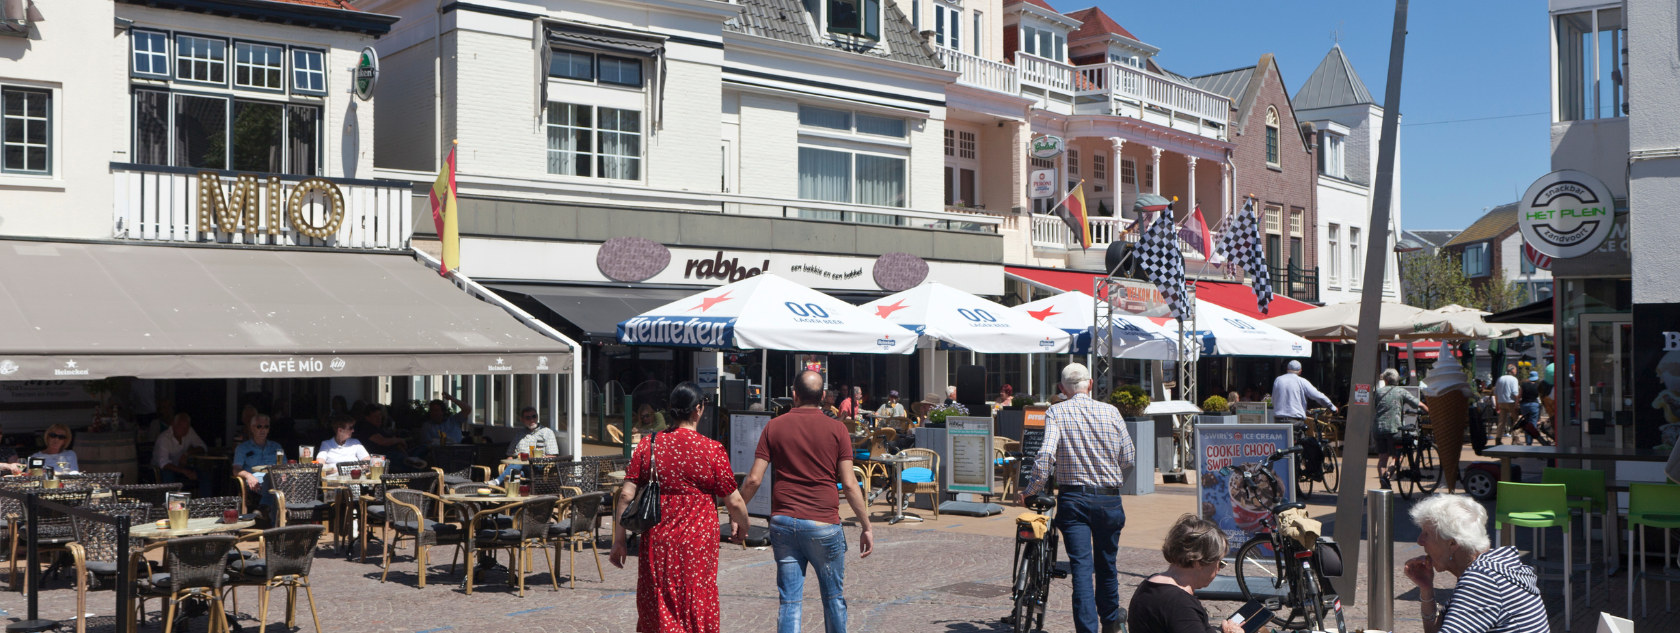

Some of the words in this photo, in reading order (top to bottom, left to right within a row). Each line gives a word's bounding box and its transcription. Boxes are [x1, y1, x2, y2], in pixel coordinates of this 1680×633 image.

[1545, 185, 1585, 198] snackbar
[198, 172, 345, 238] MIO
[1526, 210, 1556, 221] HET
[1561, 207, 1606, 218] PLEIN
[1544, 228, 1588, 242] zandvoort
[823, 270, 831, 278] en
[1127, 286, 1150, 302] WELKOM
[621, 317, 727, 345] Heineken
[260, 357, 295, 372] CAFÉ
[299, 357, 323, 372] MÍO
[1205, 432, 1233, 440] SWIRL'S
[1206, 444, 1241, 457] COOKIE
[1243, 443, 1276, 456] CHOCO
